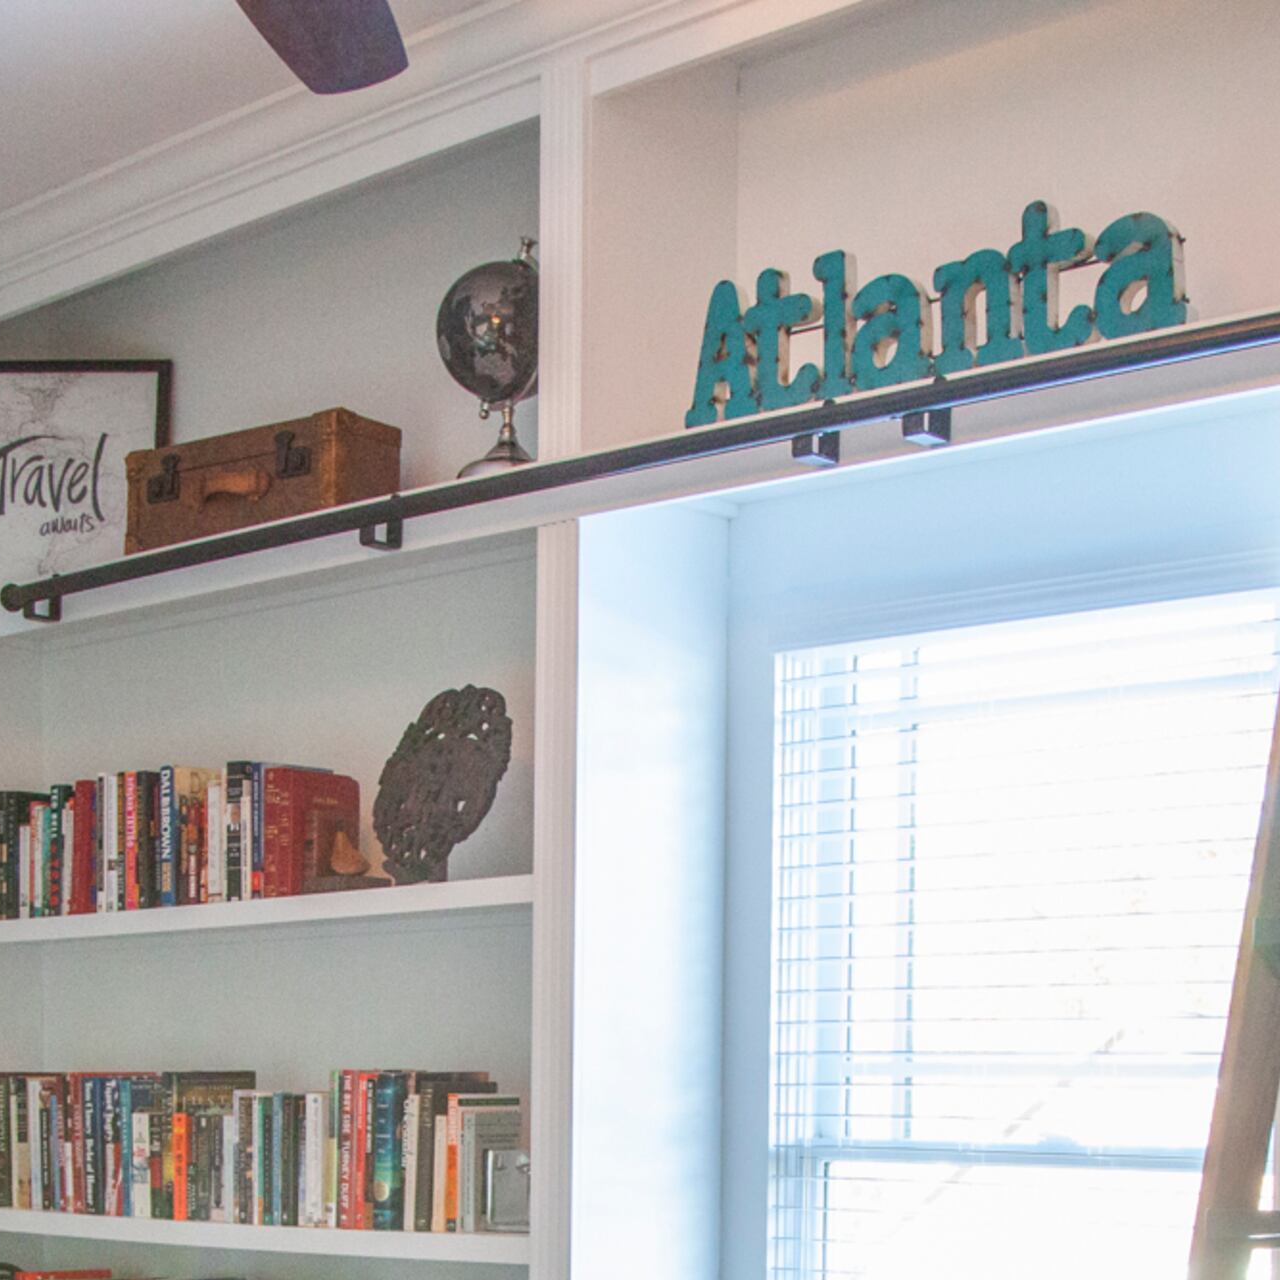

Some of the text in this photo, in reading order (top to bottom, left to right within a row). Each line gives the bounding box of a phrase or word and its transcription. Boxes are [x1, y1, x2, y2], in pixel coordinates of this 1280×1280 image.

[685, 200, 1187, 428] Atlanta
[39, 512, 96, 537] awaits
[161, 808, 172, 859] BROWN
